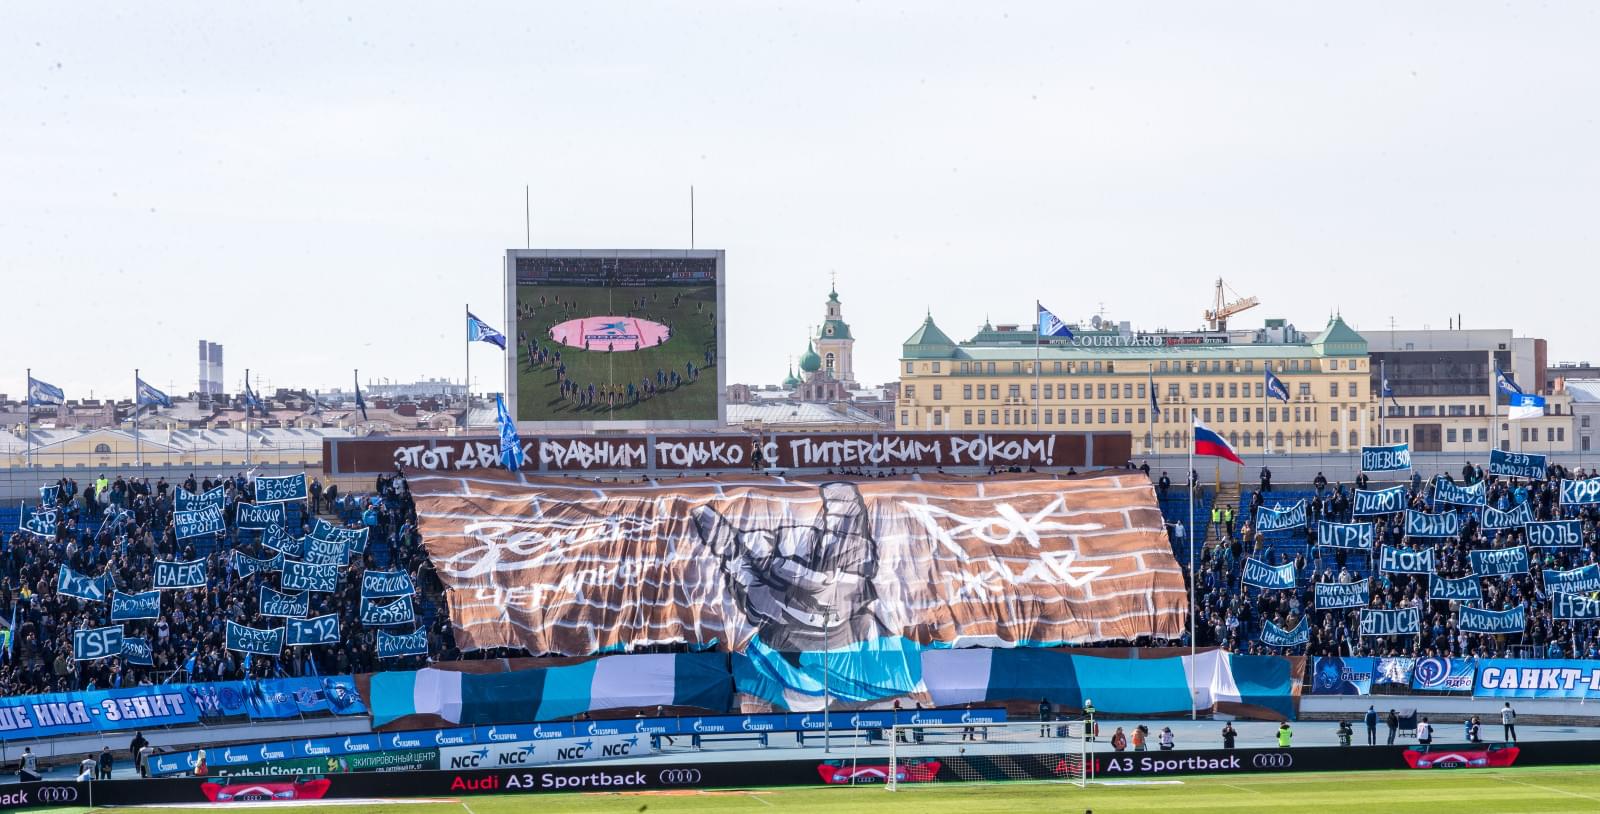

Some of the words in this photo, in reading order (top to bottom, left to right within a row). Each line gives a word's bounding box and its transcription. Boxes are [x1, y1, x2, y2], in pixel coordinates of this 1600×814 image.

[1071, 336, 1162, 346] COURTYARD
[393, 445, 454, 470] ЭТОТ
[539, 440, 646, 469] СРАВНИМ
[656, 440, 744, 467] ТОЛЬКО
[763, 442, 779, 463] С
[789, 437, 942, 467] ПИТЕРСКИМ
[950, 434, 1056, 466] РОКОМ!
[257, 475, 302, 490] BEAGLE
[266, 487, 297, 499] BOYS
[1354, 490, 1405, 510] ПИЛОТ
[1438, 490, 1483, 504] МИНУС
[240, 508, 280, 523] N-GROUP
[1257, 511, 1305, 529] АУКЦЫОН
[1484, 502, 1530, 528] СПЛИН
[1408, 514, 1457, 534] КИНО
[1320, 524, 1371, 547] ИГРЫ
[1529, 522, 1579, 544] НОЛЬ
[311, 540, 345, 553] SOUND
[1480, 550, 1524, 563] КОРОЛЬ
[157, 563, 205, 586] GAERS
[293, 564, 336, 577] CITRUS
[1481, 563, 1489, 574] И
[1498, 561, 1520, 573] ШУТ
[283, 574, 335, 591] ULTRAS
[364, 574, 409, 592] GREMLINS
[1559, 570, 1584, 581] ПОП
[1316, 584, 1368, 596] БРИГАДНЫЙ
[1433, 580, 1479, 597] АВИА
[1320, 595, 1364, 606] ПОДРЯД
[1361, 610, 1419, 634] АЛИСА
[1460, 611, 1524, 631] АКВАРИУМ
[233, 625, 278, 641] NARVA
[238, 638, 270, 652] GATE
[1341, 672, 1371, 681] GAERS
[1445, 678, 1472, 687] ЯДРО
[33, 701, 91, 727] ИМЯ
[102, 692, 187, 722] ЗЕНИТ
[557, 747, 584, 760] NCC
[602, 743, 629, 756] NCC
[353, 752, 414, 767] ЭКИПИРОВОЧНЫЙ
[414, 751, 436, 762] ЦЕНТР
[450, 756, 479, 768] NCC
[498, 752, 526, 764] NCC
[1107, 759, 1133, 772] A3
[1141, 755, 1240, 772] Sportback
[451, 776, 499, 790] Audi
[506, 774, 534, 788] A3
[541, 771, 647, 788] Sportback
[0, 789, 28, 805] ack
